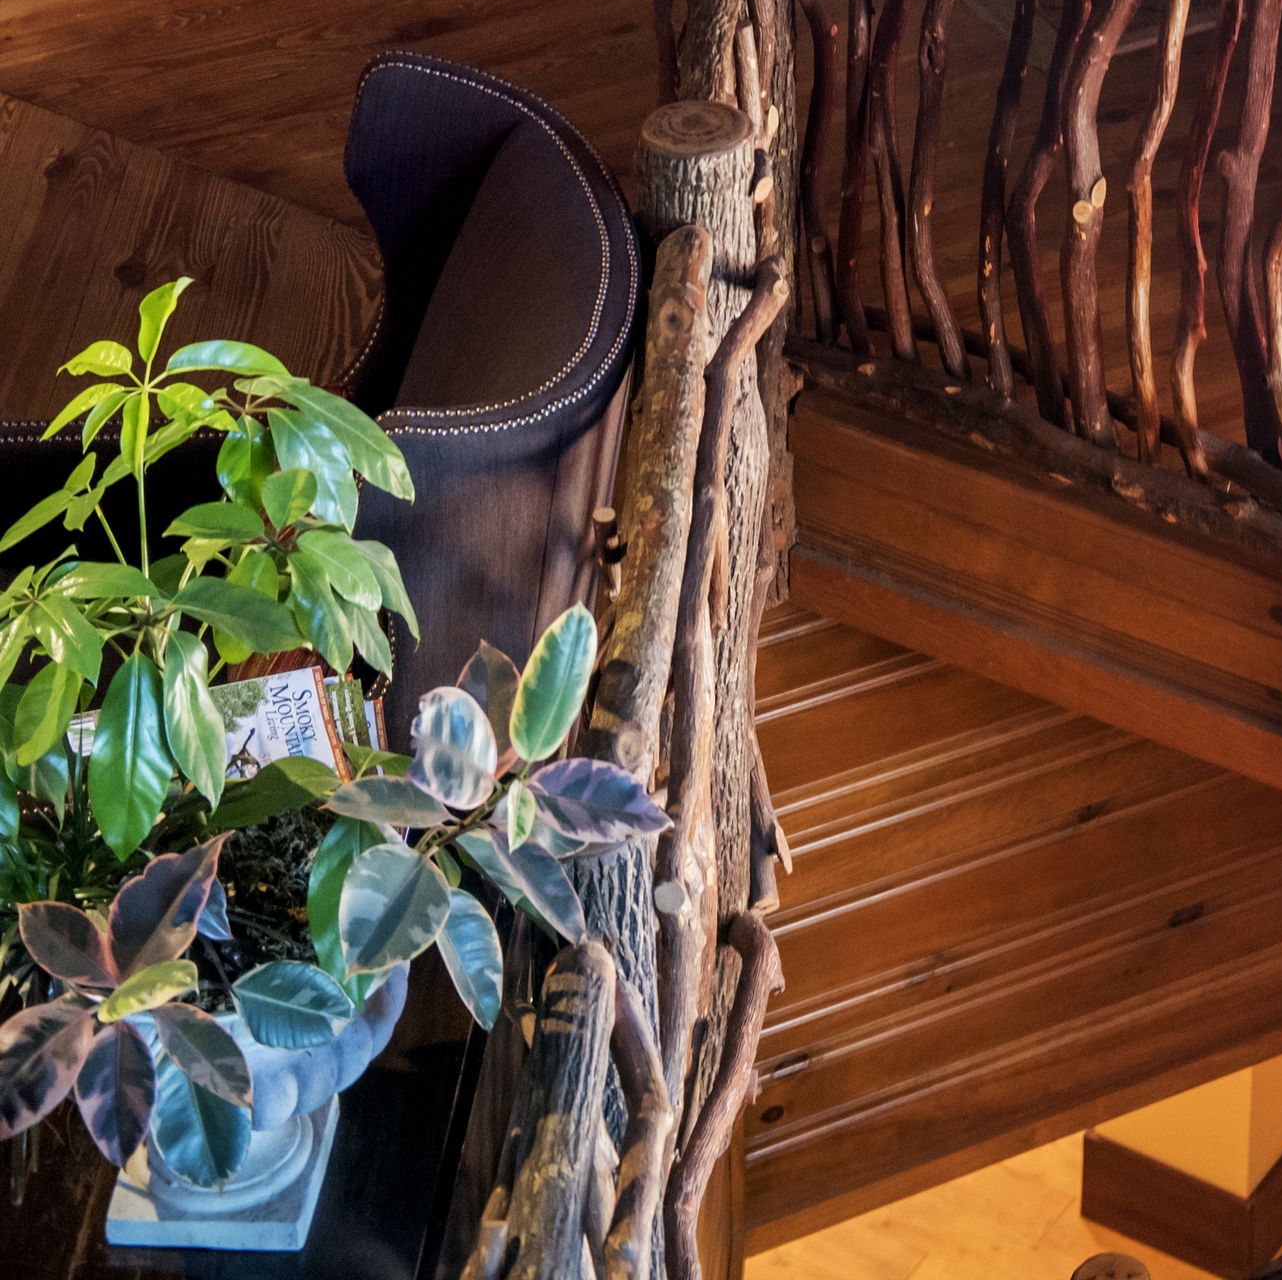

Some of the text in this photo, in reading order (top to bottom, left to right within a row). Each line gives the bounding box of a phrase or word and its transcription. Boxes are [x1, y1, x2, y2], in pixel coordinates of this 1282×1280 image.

[265, 710, 279, 741] Living
[269, 682, 304, 758] MOUNTAI
[292, 689, 317, 742] SMOKY
